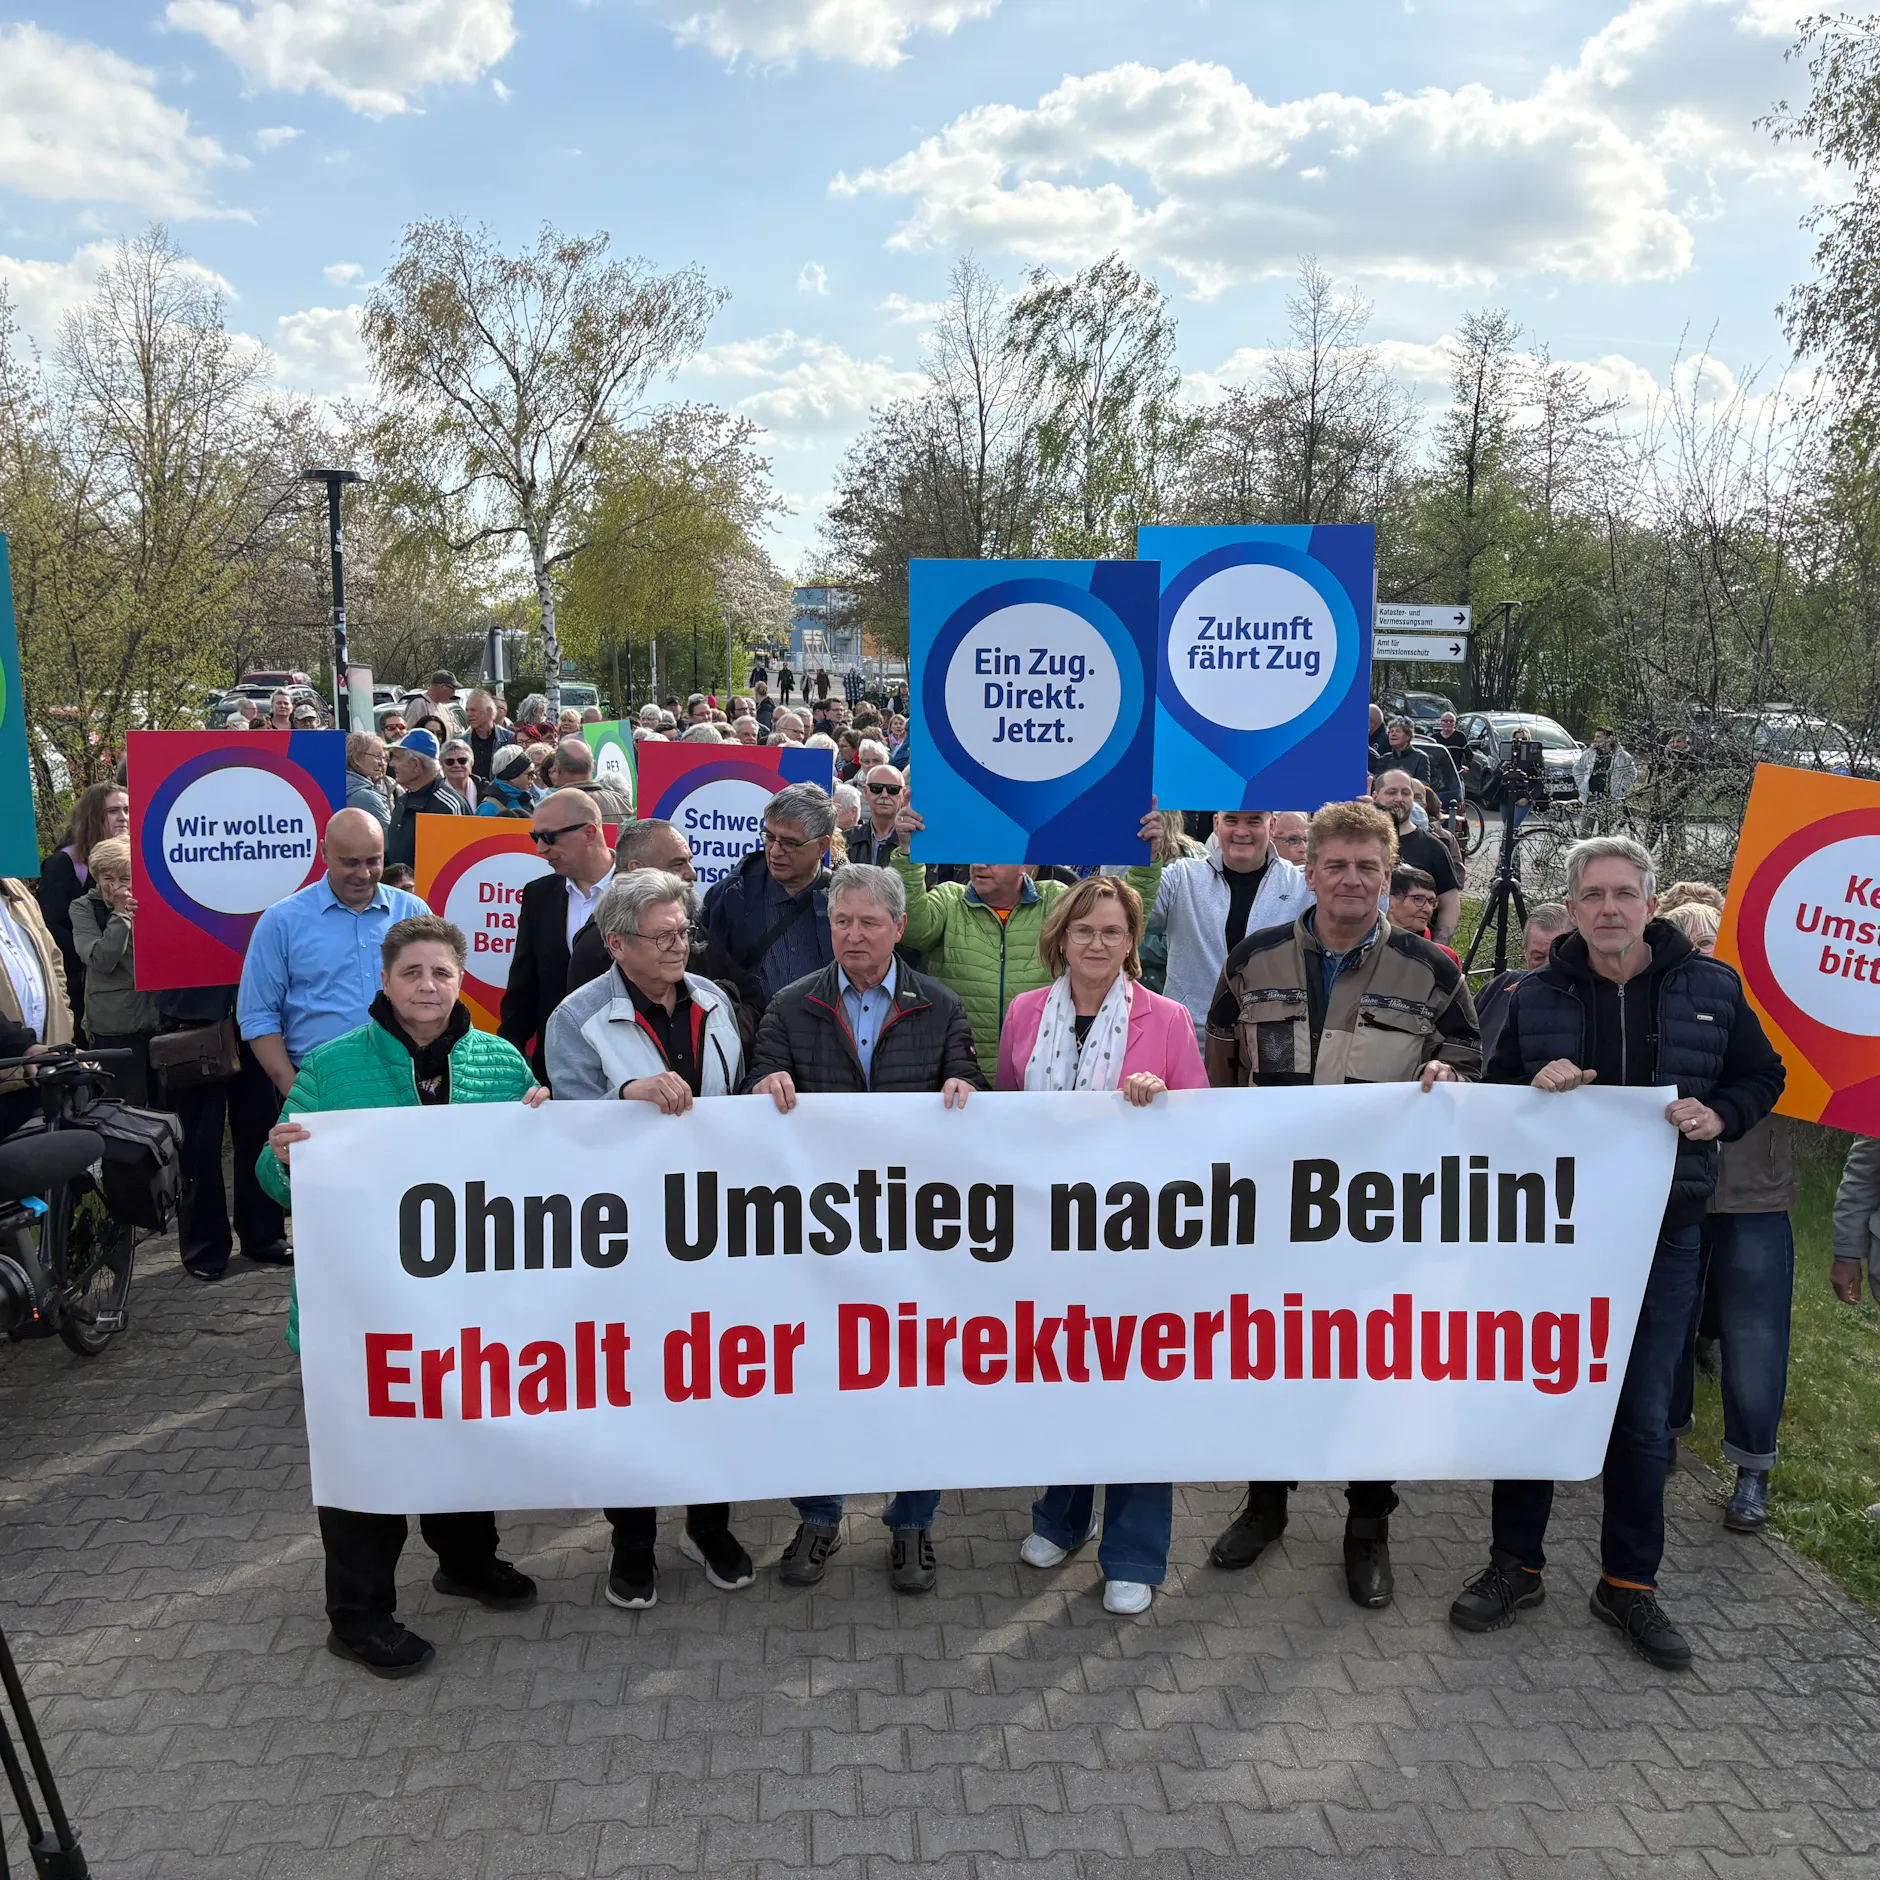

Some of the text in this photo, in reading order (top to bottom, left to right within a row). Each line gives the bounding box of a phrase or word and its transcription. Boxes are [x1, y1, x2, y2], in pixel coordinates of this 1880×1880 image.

[1379, 608, 1421, 617] Kataster- und
[1379, 618, 1433, 627] Vermessungsamt
[1197, 615, 1313, 641] Zukunft
[1376, 648, 1430, 657] Immissionsschutz
[1377, 639, 1400, 647] Amt für
[974, 647, 1096, 683] Ein Zug.
[1187, 644, 1321, 677] fährt Zug
[984, 682, 1085, 710] Direkt.
[992, 716, 1075, 744] Jetzt.
[606, 760, 620, 773] RE3
[176, 814, 304, 837] Wir wollen
[169, 838, 312, 864] durchfahren!
[486, 912, 521, 929] na
[1795, 902, 1880, 947] Ums
[399, 1155, 1576, 1278] Ohne Umstieg nach Berlin!
[365, 1292, 1611, 1420] Erhalt der Direktverbindung!
